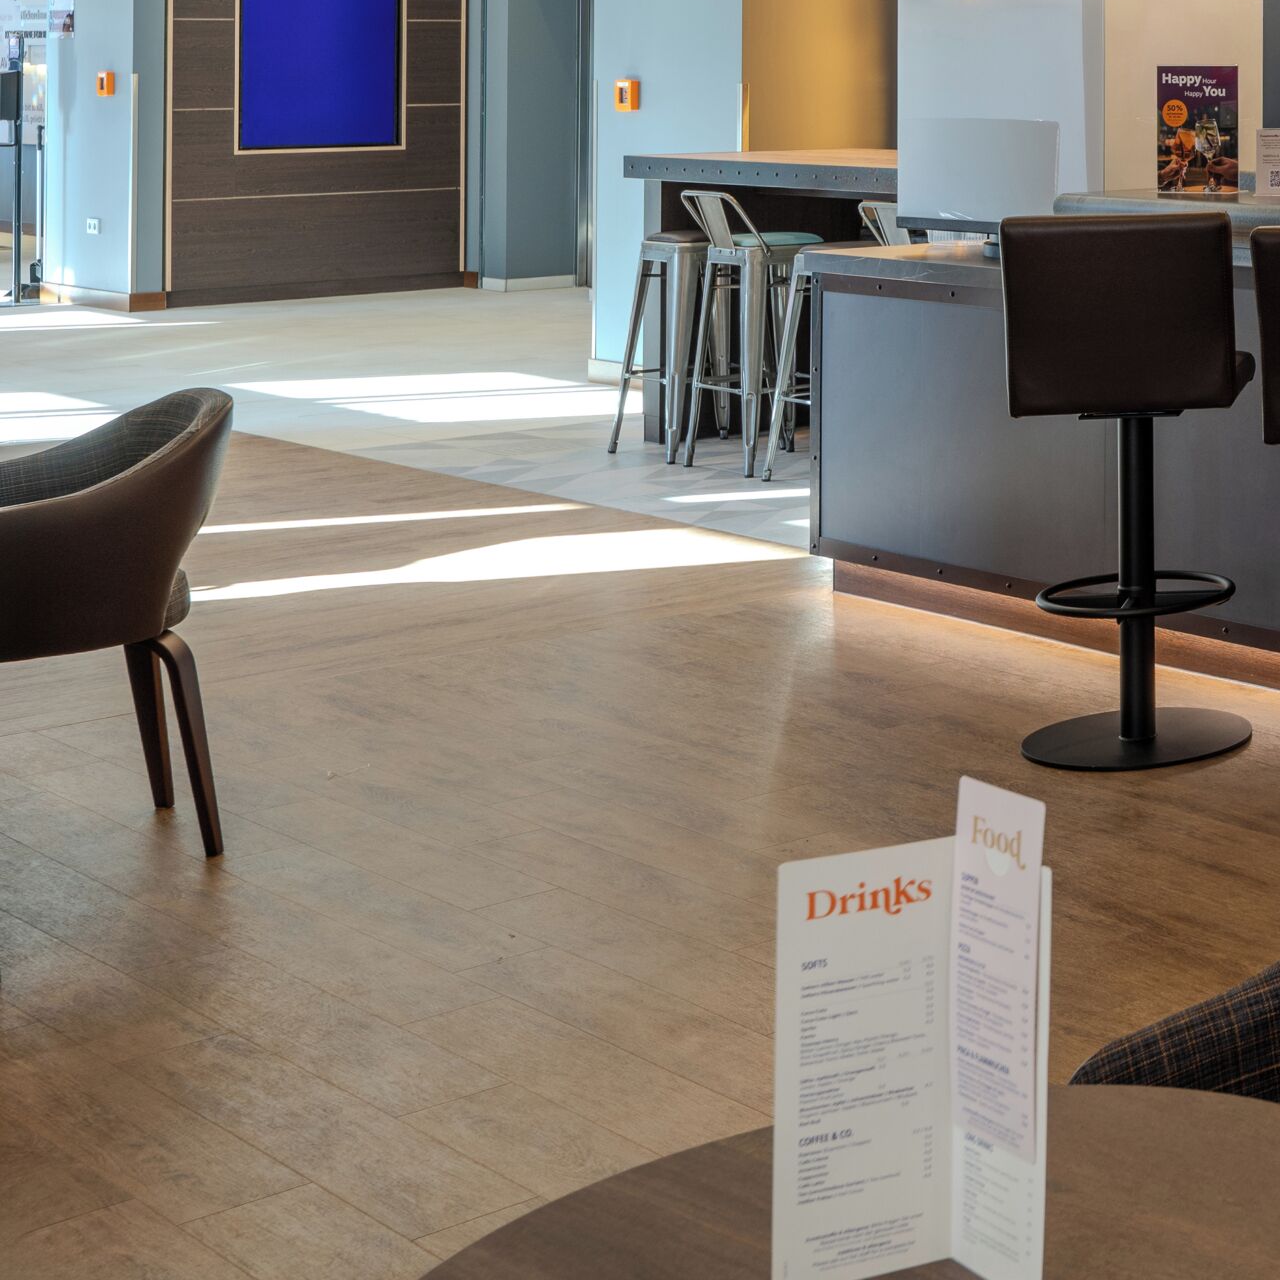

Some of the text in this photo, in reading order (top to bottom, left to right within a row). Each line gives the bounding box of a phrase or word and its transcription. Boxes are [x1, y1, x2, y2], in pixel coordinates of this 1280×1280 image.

[1162, 73, 1202, 87] Happy
[1184, 86, 1226, 98] Happy You
[971, 815, 1026, 870] Food
[806, 876, 933, 921] Drinks
[801, 958, 828, 971] SOFTS
